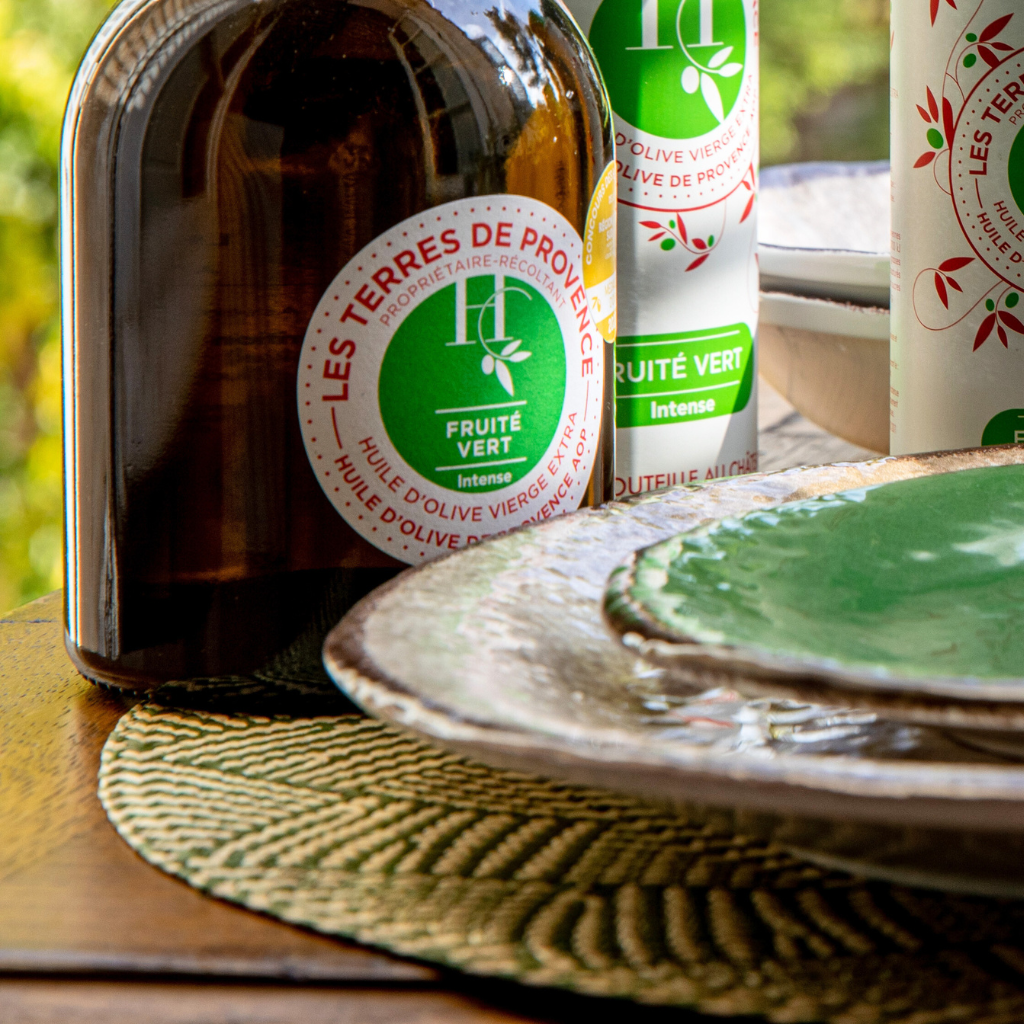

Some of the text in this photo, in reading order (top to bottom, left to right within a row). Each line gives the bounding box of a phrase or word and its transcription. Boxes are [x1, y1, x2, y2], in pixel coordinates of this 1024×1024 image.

[689, 126, 736, 162] VIERGE
[969, 129, 992, 176] LES
[670, 174, 692, 188] DE
[976, 212, 1011, 254] HUILE
[379, 254, 567, 327] PROPRIÉTAIRE-RÉCOLTANT
[322, 222, 594, 401] LES TERRES DE PROVENCE
[616, 346, 743, 383] RUITÉ VERT
[446, 410, 522, 439] FRUITÉ
[651, 398, 716, 419] Intense
[457, 436, 512, 459] VERT
[358, 411, 578, 522] HUILE D'OLIVE VIERGE EXTRA
[457, 471, 513, 489] Intense
[334, 454, 383, 511] HUILE
[380, 506, 461, 550] D'OLIVE
[572, 428, 588, 473] AOP
